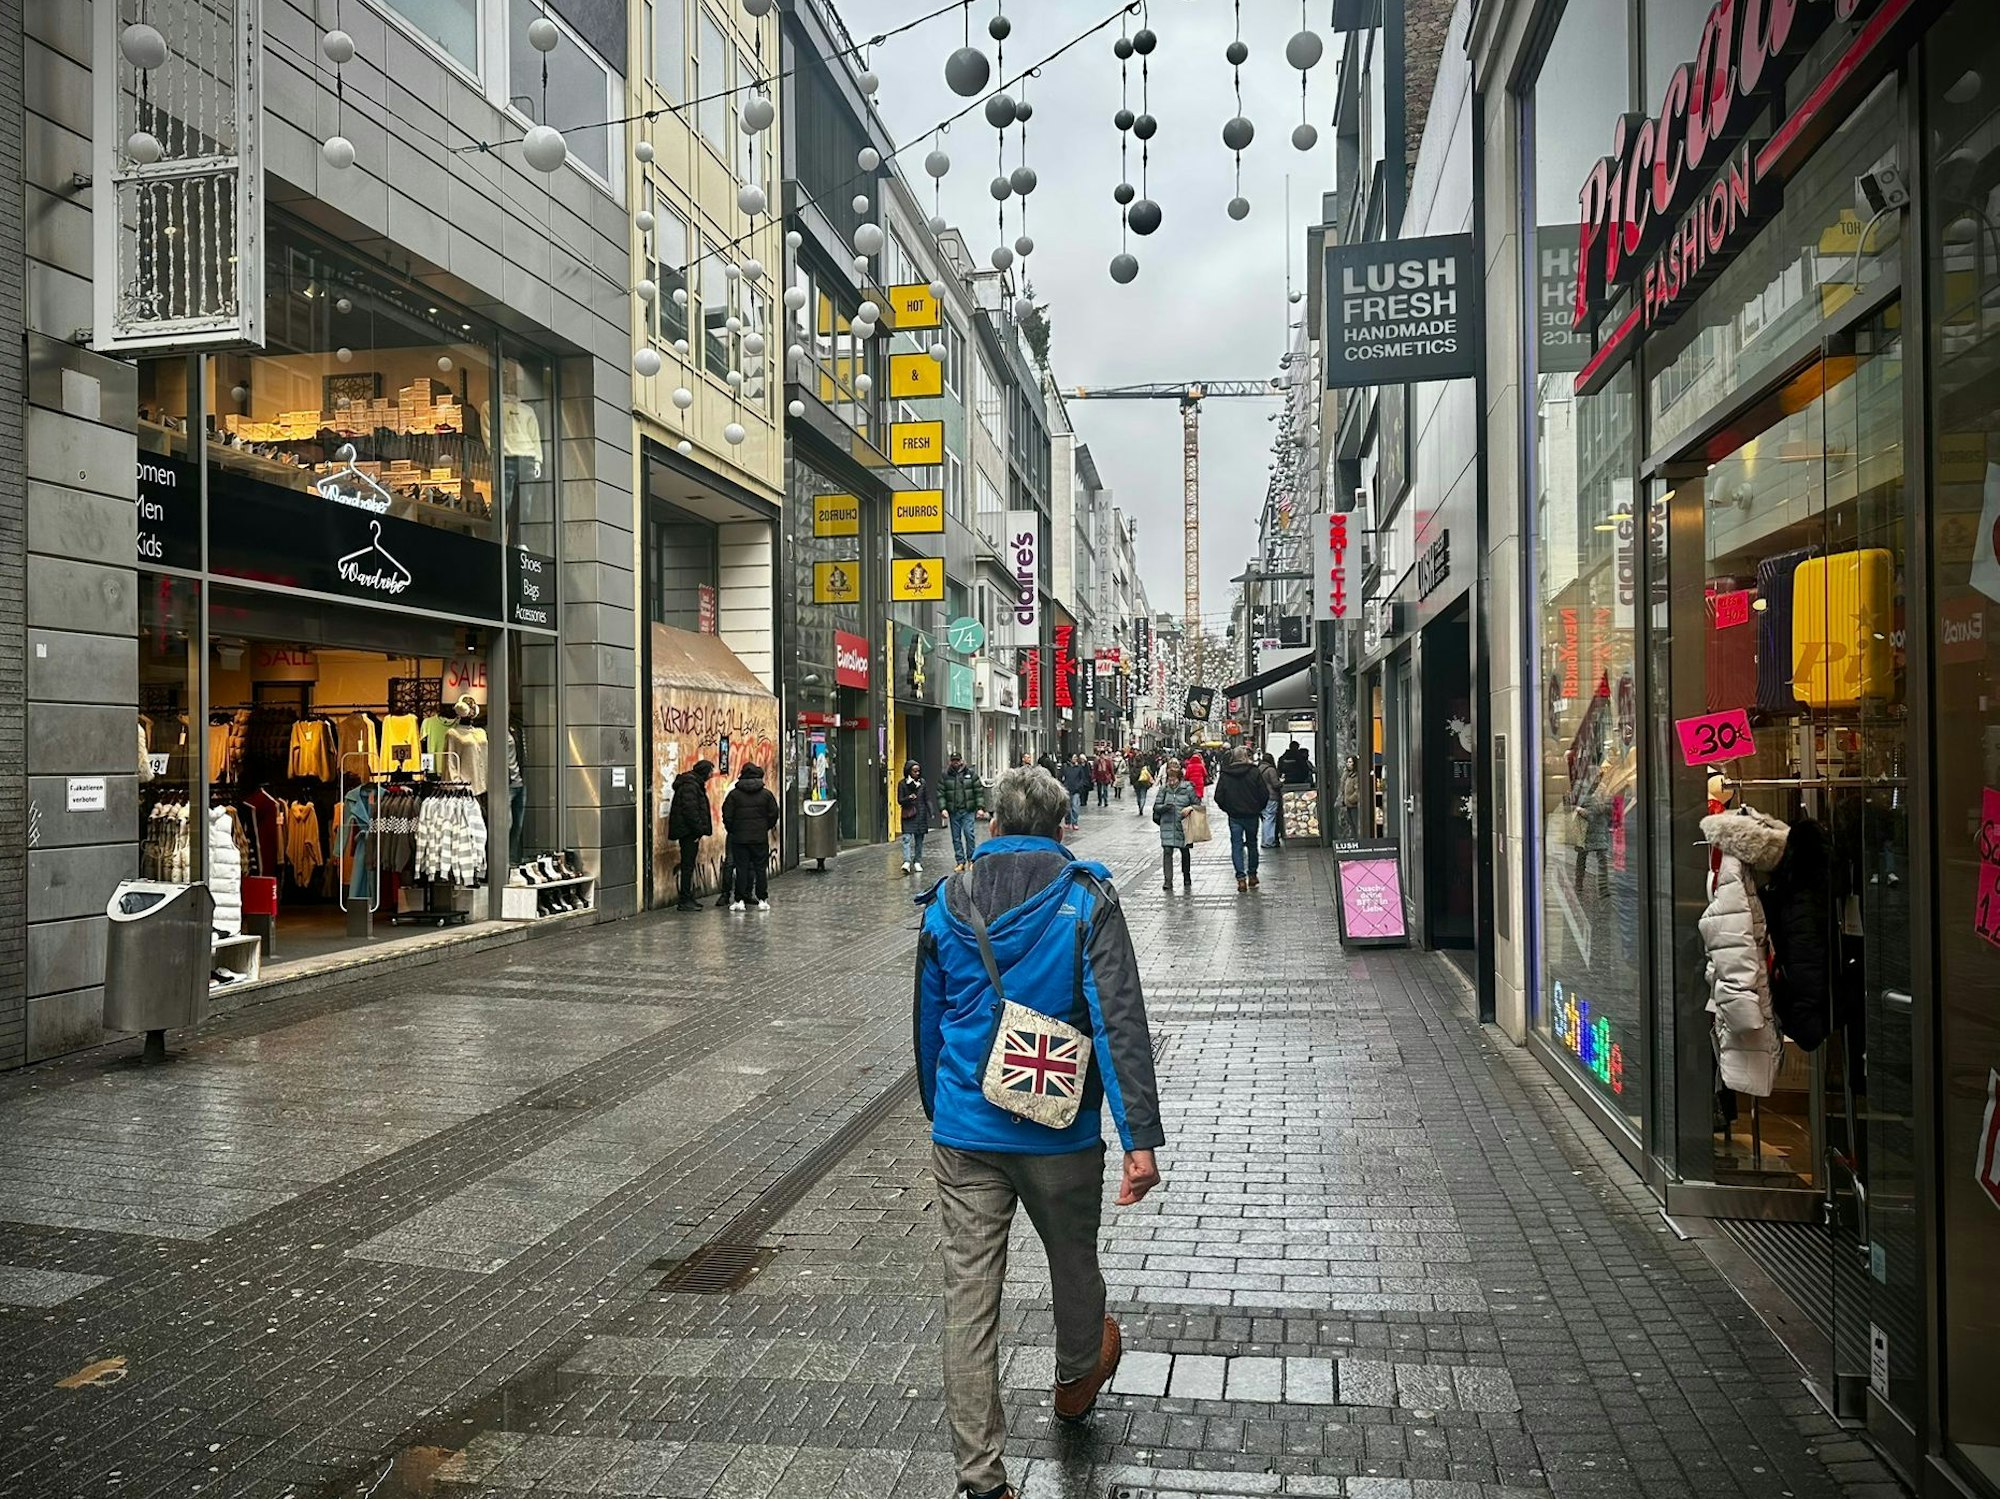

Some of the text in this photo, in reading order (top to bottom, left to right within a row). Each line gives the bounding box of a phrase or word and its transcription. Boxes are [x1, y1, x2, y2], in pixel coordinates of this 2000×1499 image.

[1644, 141, 1748, 330] FASHION
[1343, 257, 1456, 294] LUSH
[907, 300, 924, 312] HOT
[1343, 290, 1456, 323] FRESH
[1344, 319, 1457, 342] HANDMADE
[1344, 339, 1457, 361] COSMETICS
[912, 370, 919, 381] &
[903, 437, 930, 449] FRESH
[136, 463, 176, 487] omen
[897, 505, 938, 517] CHURROS
[520, 553, 542, 572] Shoes
[341, 562, 407, 594] Wardrobe
[1010, 532, 1034, 625] claire's
[523, 579, 540, 600] Bags
[515, 604, 547, 623] Accessories
[259, 650, 313, 667] SALE
[449, 662, 486, 688] SALE
[1026, 1009, 1058, 1025] LONDON
